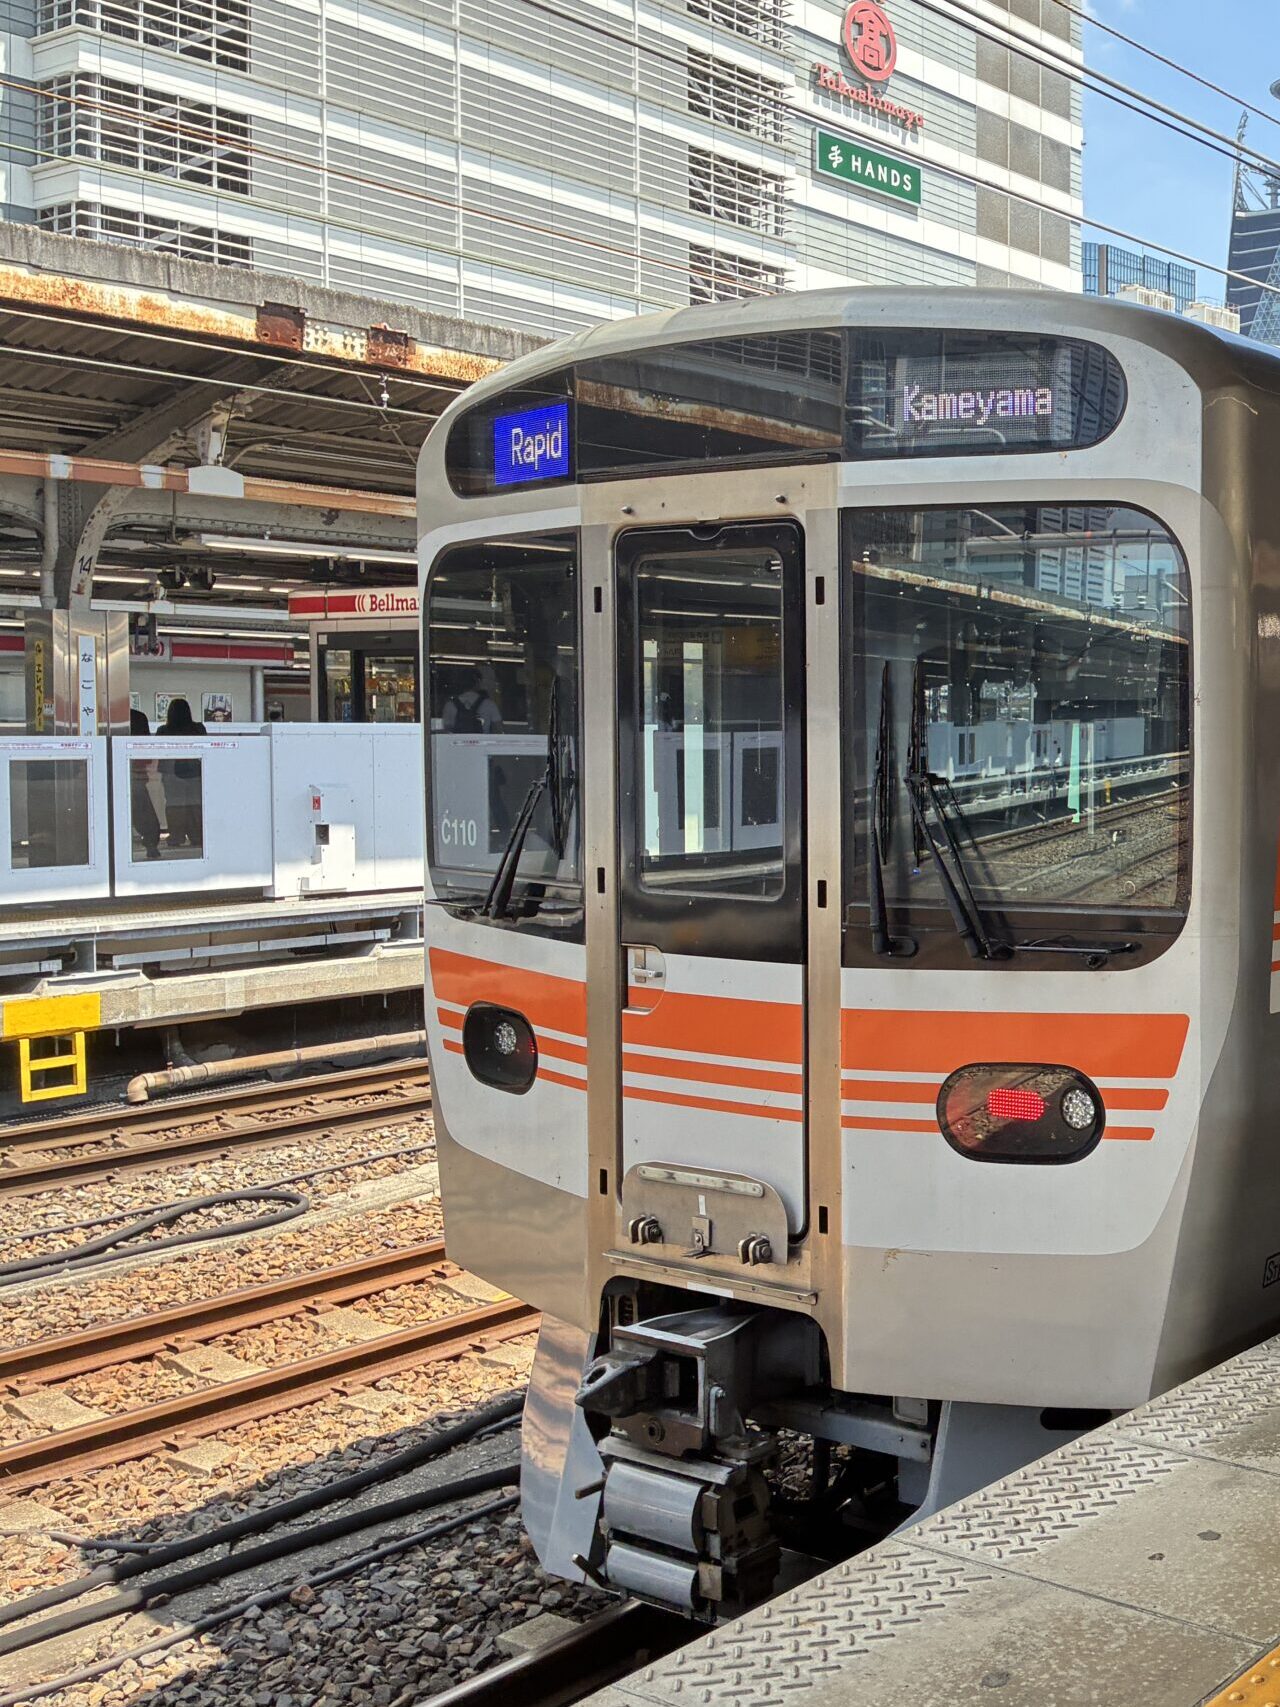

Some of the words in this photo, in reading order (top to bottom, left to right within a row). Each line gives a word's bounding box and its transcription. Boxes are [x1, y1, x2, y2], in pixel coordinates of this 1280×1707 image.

[812, 62, 924, 129] Takashimaya
[851, 154, 912, 192] HANDS
[903, 385, 1052, 425] Kameyama
[511, 419, 562, 471] Rapid
[79, 556, 93, 574] 14
[369, 593, 420, 612] Bellma
[441, 818, 477, 847] C110
